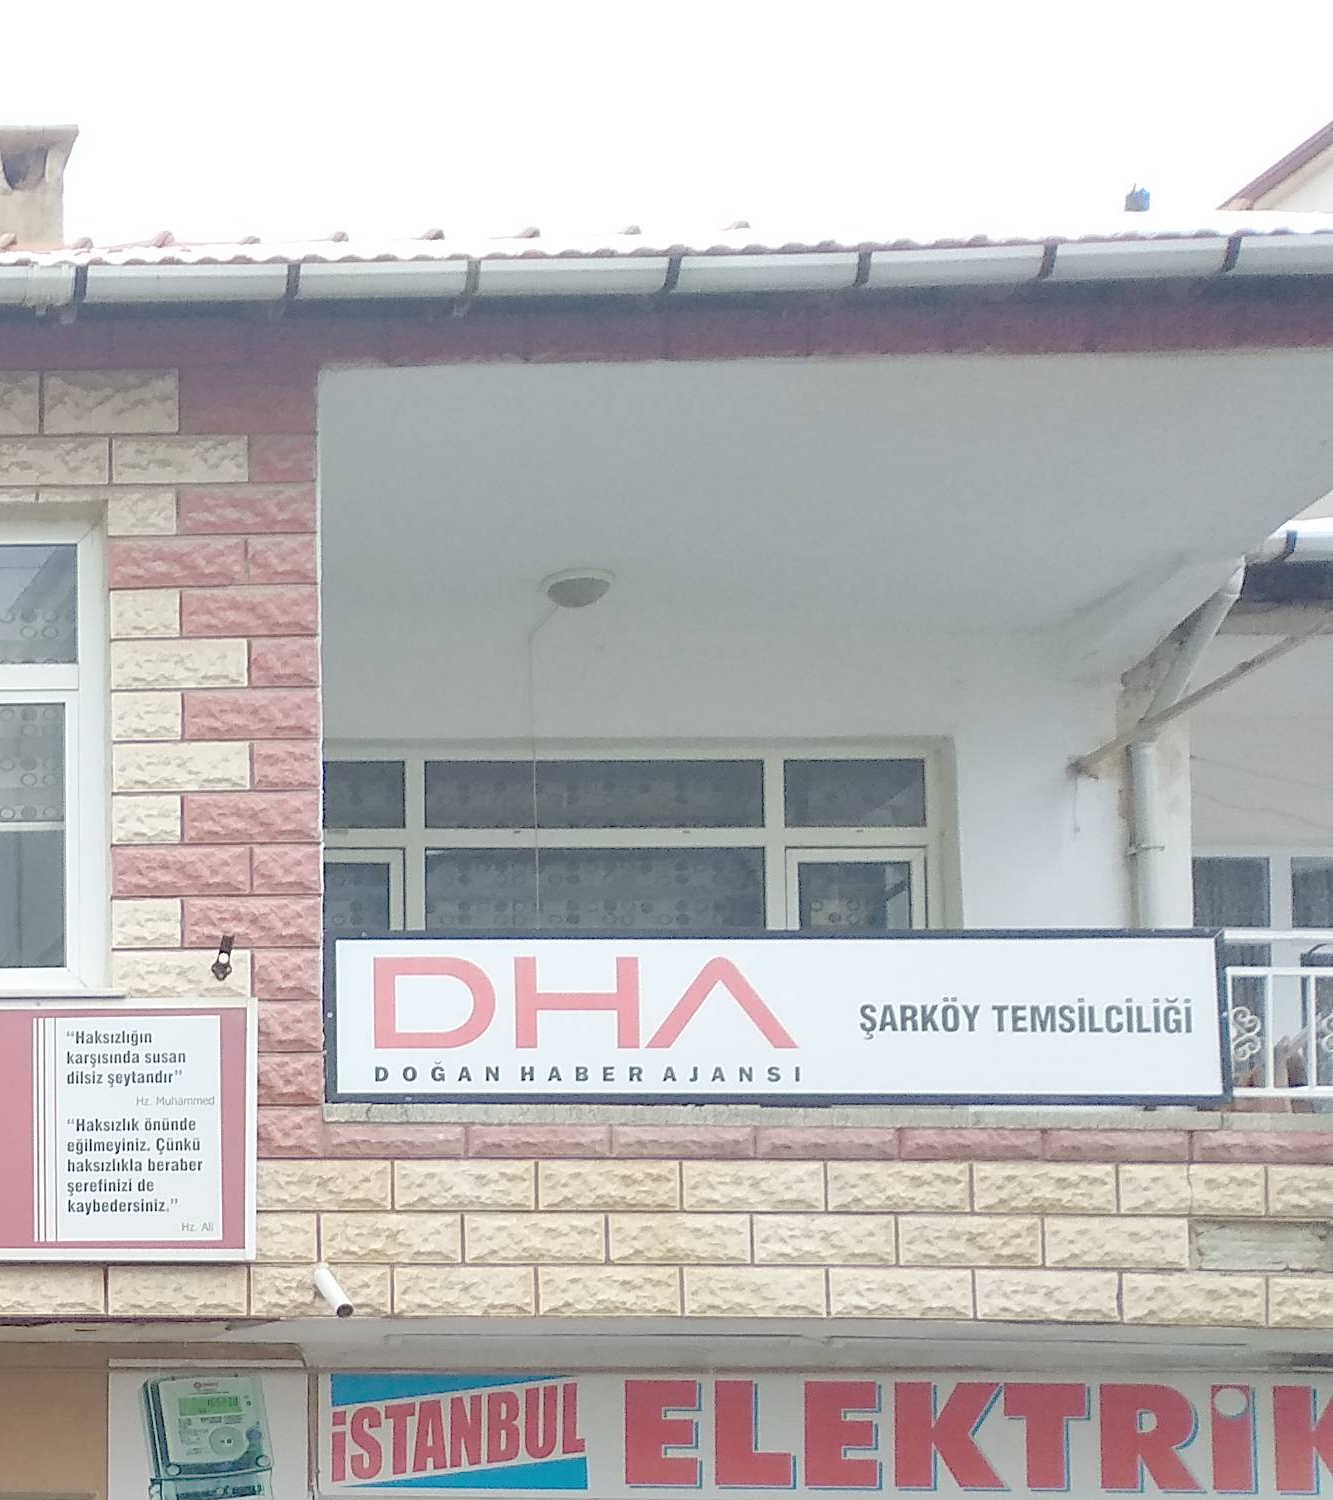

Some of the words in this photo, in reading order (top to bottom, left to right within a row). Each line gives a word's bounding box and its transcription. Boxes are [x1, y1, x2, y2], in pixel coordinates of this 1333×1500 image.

[372, 955, 799, 1050] DHA
[859, 998, 982, 1041] ŞARKÖY
[991, 994, 1194, 1035] TEMSİLCİLİĞİ
[66, 1050, 140, 1068] karşısında
[144, 1051, 186, 1064] susan
[66, 1071, 103, 1085] dilsiz
[373, 1062, 502, 1083] DOĞAN
[519, 1066, 643, 1083] HABER
[662, 1066, 803, 1083] AJANSI
[156, 1096, 216, 1107] Muhammed
[144, 1117, 197, 1131] önünde
[67, 1138, 151, 1155] eğilmeyiniz.
[156, 1137, 201, 1155] Çünkü
[67, 1158, 143, 1172] haksızlıkla
[147, 1158, 204, 1172] beraber
[67, 1178, 133, 1196] şerefinizi
[137, 1179, 155, 1192] de
